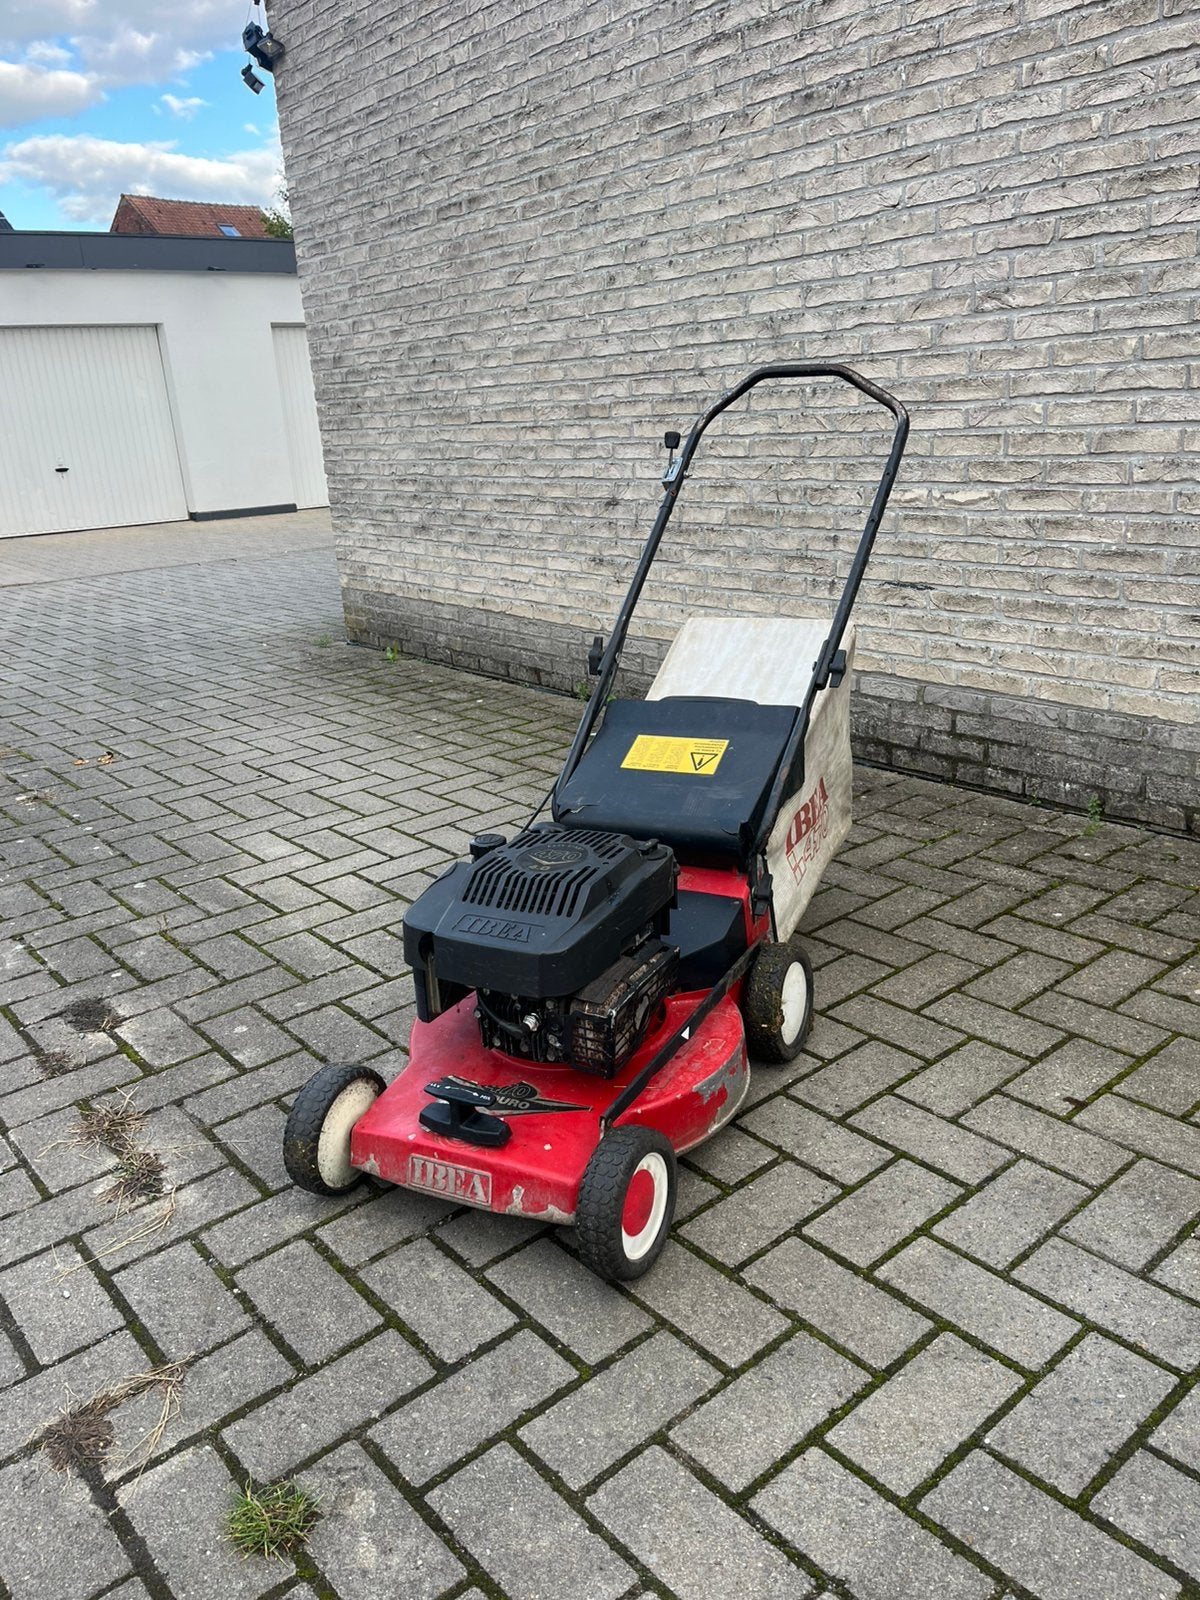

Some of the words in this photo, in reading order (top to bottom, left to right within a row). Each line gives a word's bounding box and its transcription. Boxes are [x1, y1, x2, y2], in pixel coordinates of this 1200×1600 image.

[458, 918, 532, 943] IBEA
[496, 1095, 530, 1110] URO
[412, 1158, 488, 1203] IBEA
